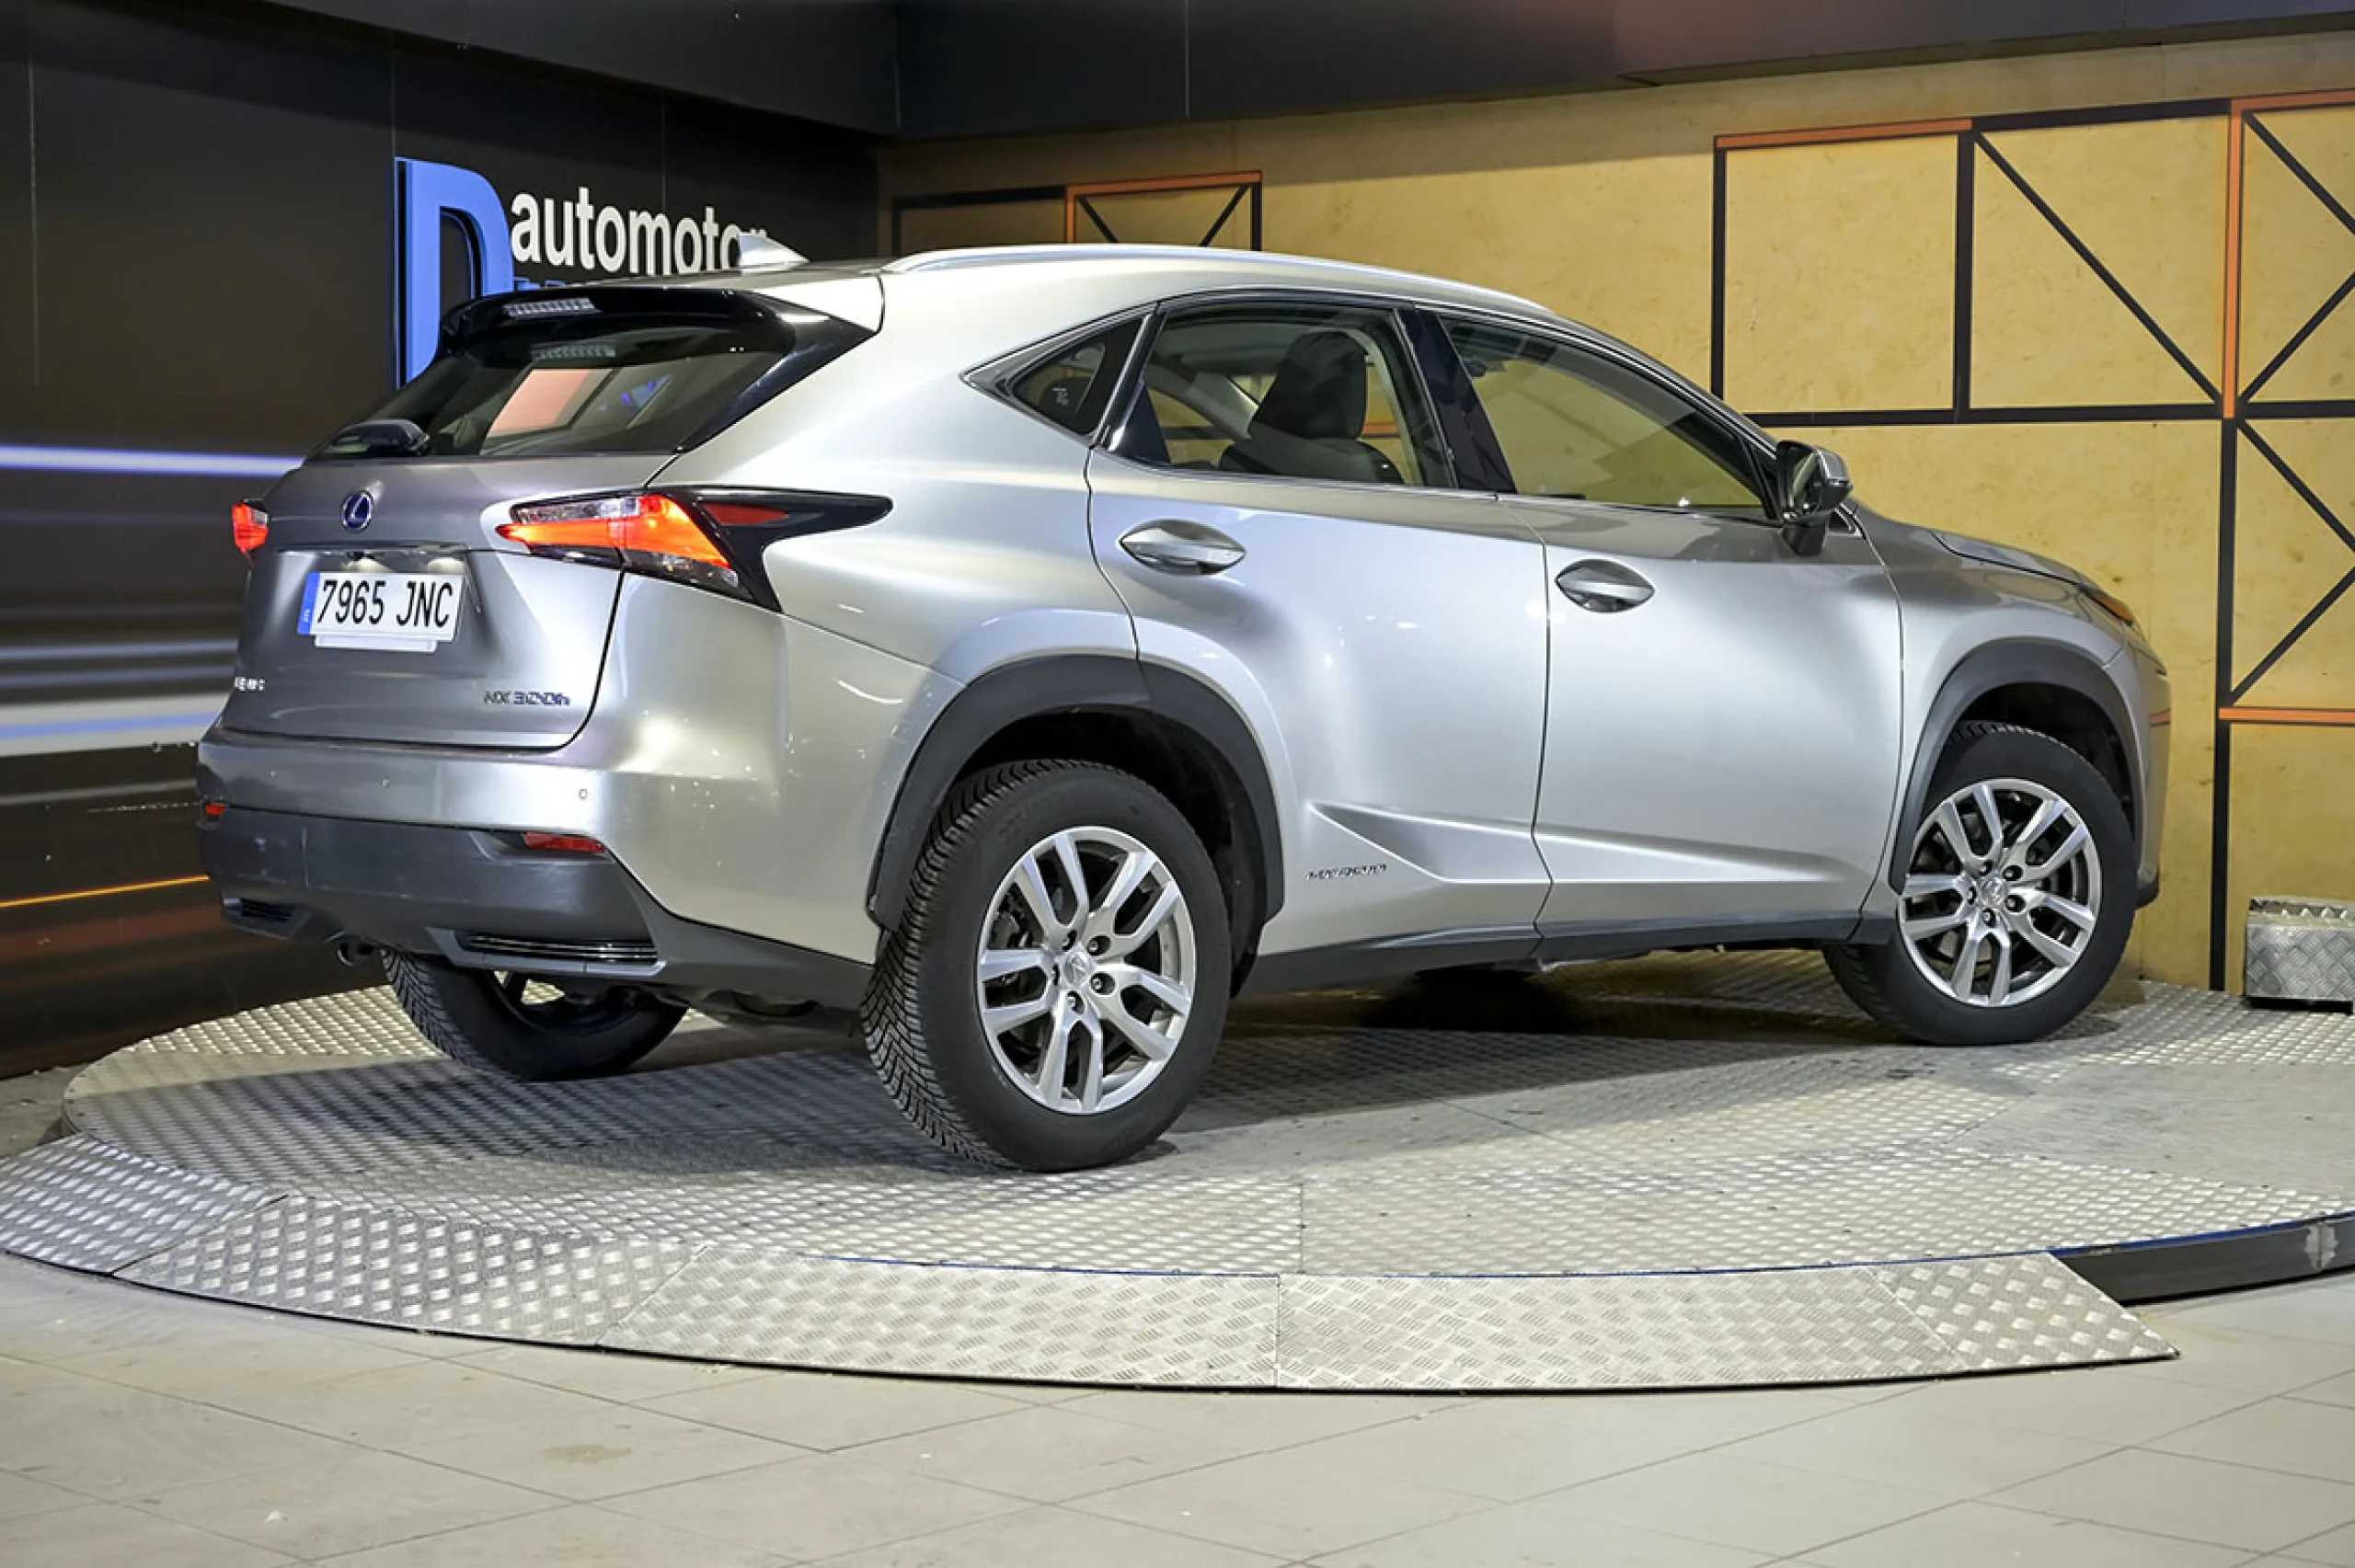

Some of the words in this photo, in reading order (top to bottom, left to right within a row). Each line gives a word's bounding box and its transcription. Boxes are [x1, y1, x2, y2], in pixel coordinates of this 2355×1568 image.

[511, 187, 767, 275] automoto
[317, 579, 386, 625] 7965
[396, 580, 454, 628] JNC
